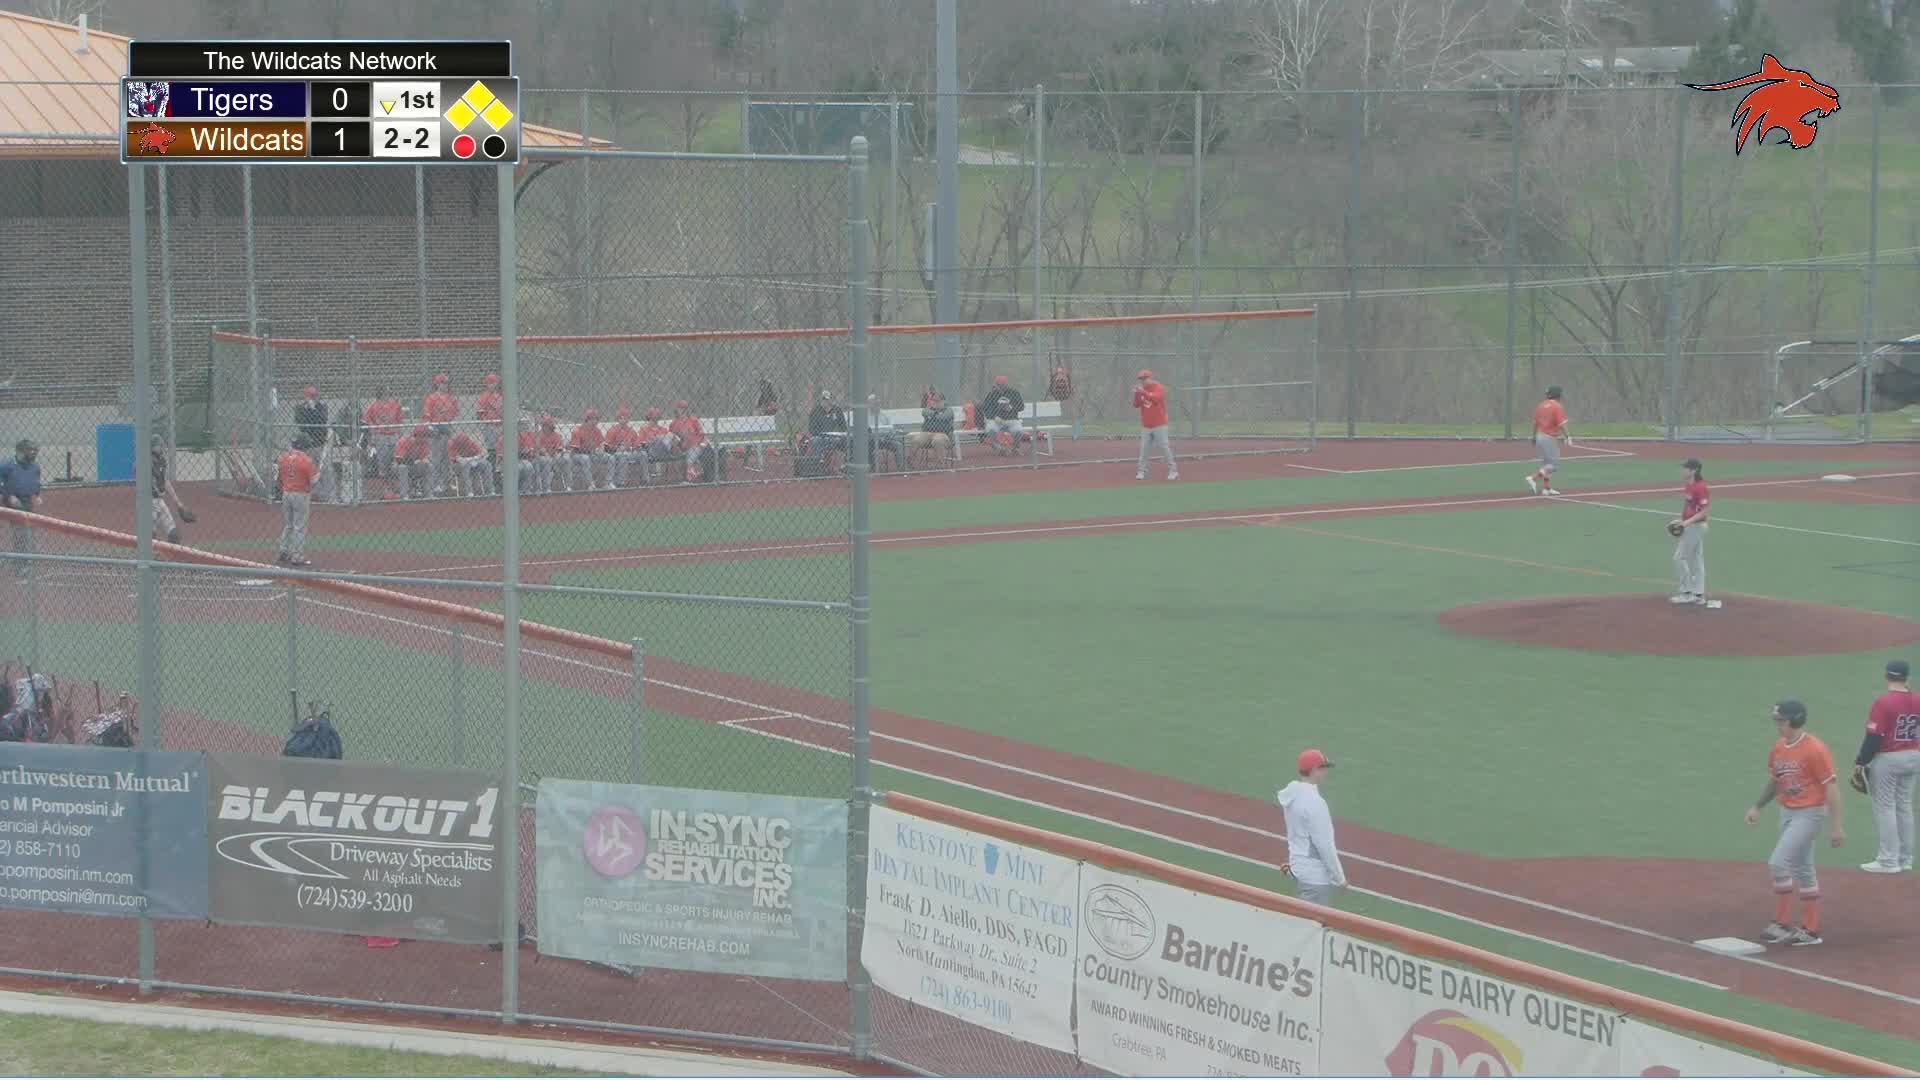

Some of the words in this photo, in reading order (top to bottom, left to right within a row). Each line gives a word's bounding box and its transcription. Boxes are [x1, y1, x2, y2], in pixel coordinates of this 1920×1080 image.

[0, 765, 110, 790] rthwestern
[14, 797, 28, 811] M
[32, 798, 108, 817] Pomposini
[111, 803, 126, 817] Jr
[42, 821, 94, 837] Advisor
[650, 808, 793, 849] IN-SYNC
[16, 840, 81, 858] 858-7110
[330, 842, 409, 872] Driveway
[410, 848, 493, 872] Specialists
[657, 840, 784, 863] REHABILITATION
[896, 822, 977, 867] KEYSTONE
[363, 868, 379, 882] All
[383, 871, 423, 888] Asphalt
[425, 874, 462, 888] Needs
[645, 853, 793, 891] SERVICES
[297, 883, 414, 913] (724)539-3200
[752, 888, 792, 909] INC.
[873, 848, 929, 887] DENTAL
[934, 867, 1002, 909] IMPLANT
[1008, 888, 1073, 929] CENTER
[584, 896, 652, 914] ORTHOPEDIC
[664, 904, 710, 919] SPORTS
[712, 909, 750, 921] INJURY
[753, 911, 792, 926] REHAB
[879, 883, 912, 913] Frank
[920, 897, 935, 919] D.
[1024, 928, 1068, 958] FAGD
[618, 931, 750, 956] INSYNCREHAB.COM
[932, 928, 976, 960] Parkway
[1000, 953, 1027, 973] Suite
[1029, 958, 1038, 974] 2
[1160, 923, 1315, 998] Bardine's
[991, 972, 1007, 992] PA
[1008, 975, 1038, 1000] 15642
[1083, 954, 1153, 1001] Country
[1157, 976, 1270, 1032] Smokehouse
[1276, 1010, 1313, 1043] Inc.
[1329, 936, 1433, 996] LATROBE
[1441, 970, 1516, 1017] DAIRY
[1524, 993, 1616, 1047] QUEEN
[1090, 999, 1127, 1022] AWARD
[1128, 1008, 1174, 1037] WINNING
[1175, 1025, 1206, 1045] FRESH
[1207, 1036, 1216, 1050] &
[1217, 1039, 1260, 1065] SMOKED
[1263, 1052, 1302, 1075] MEATS
[1155, 1046, 1167, 1061] PA
